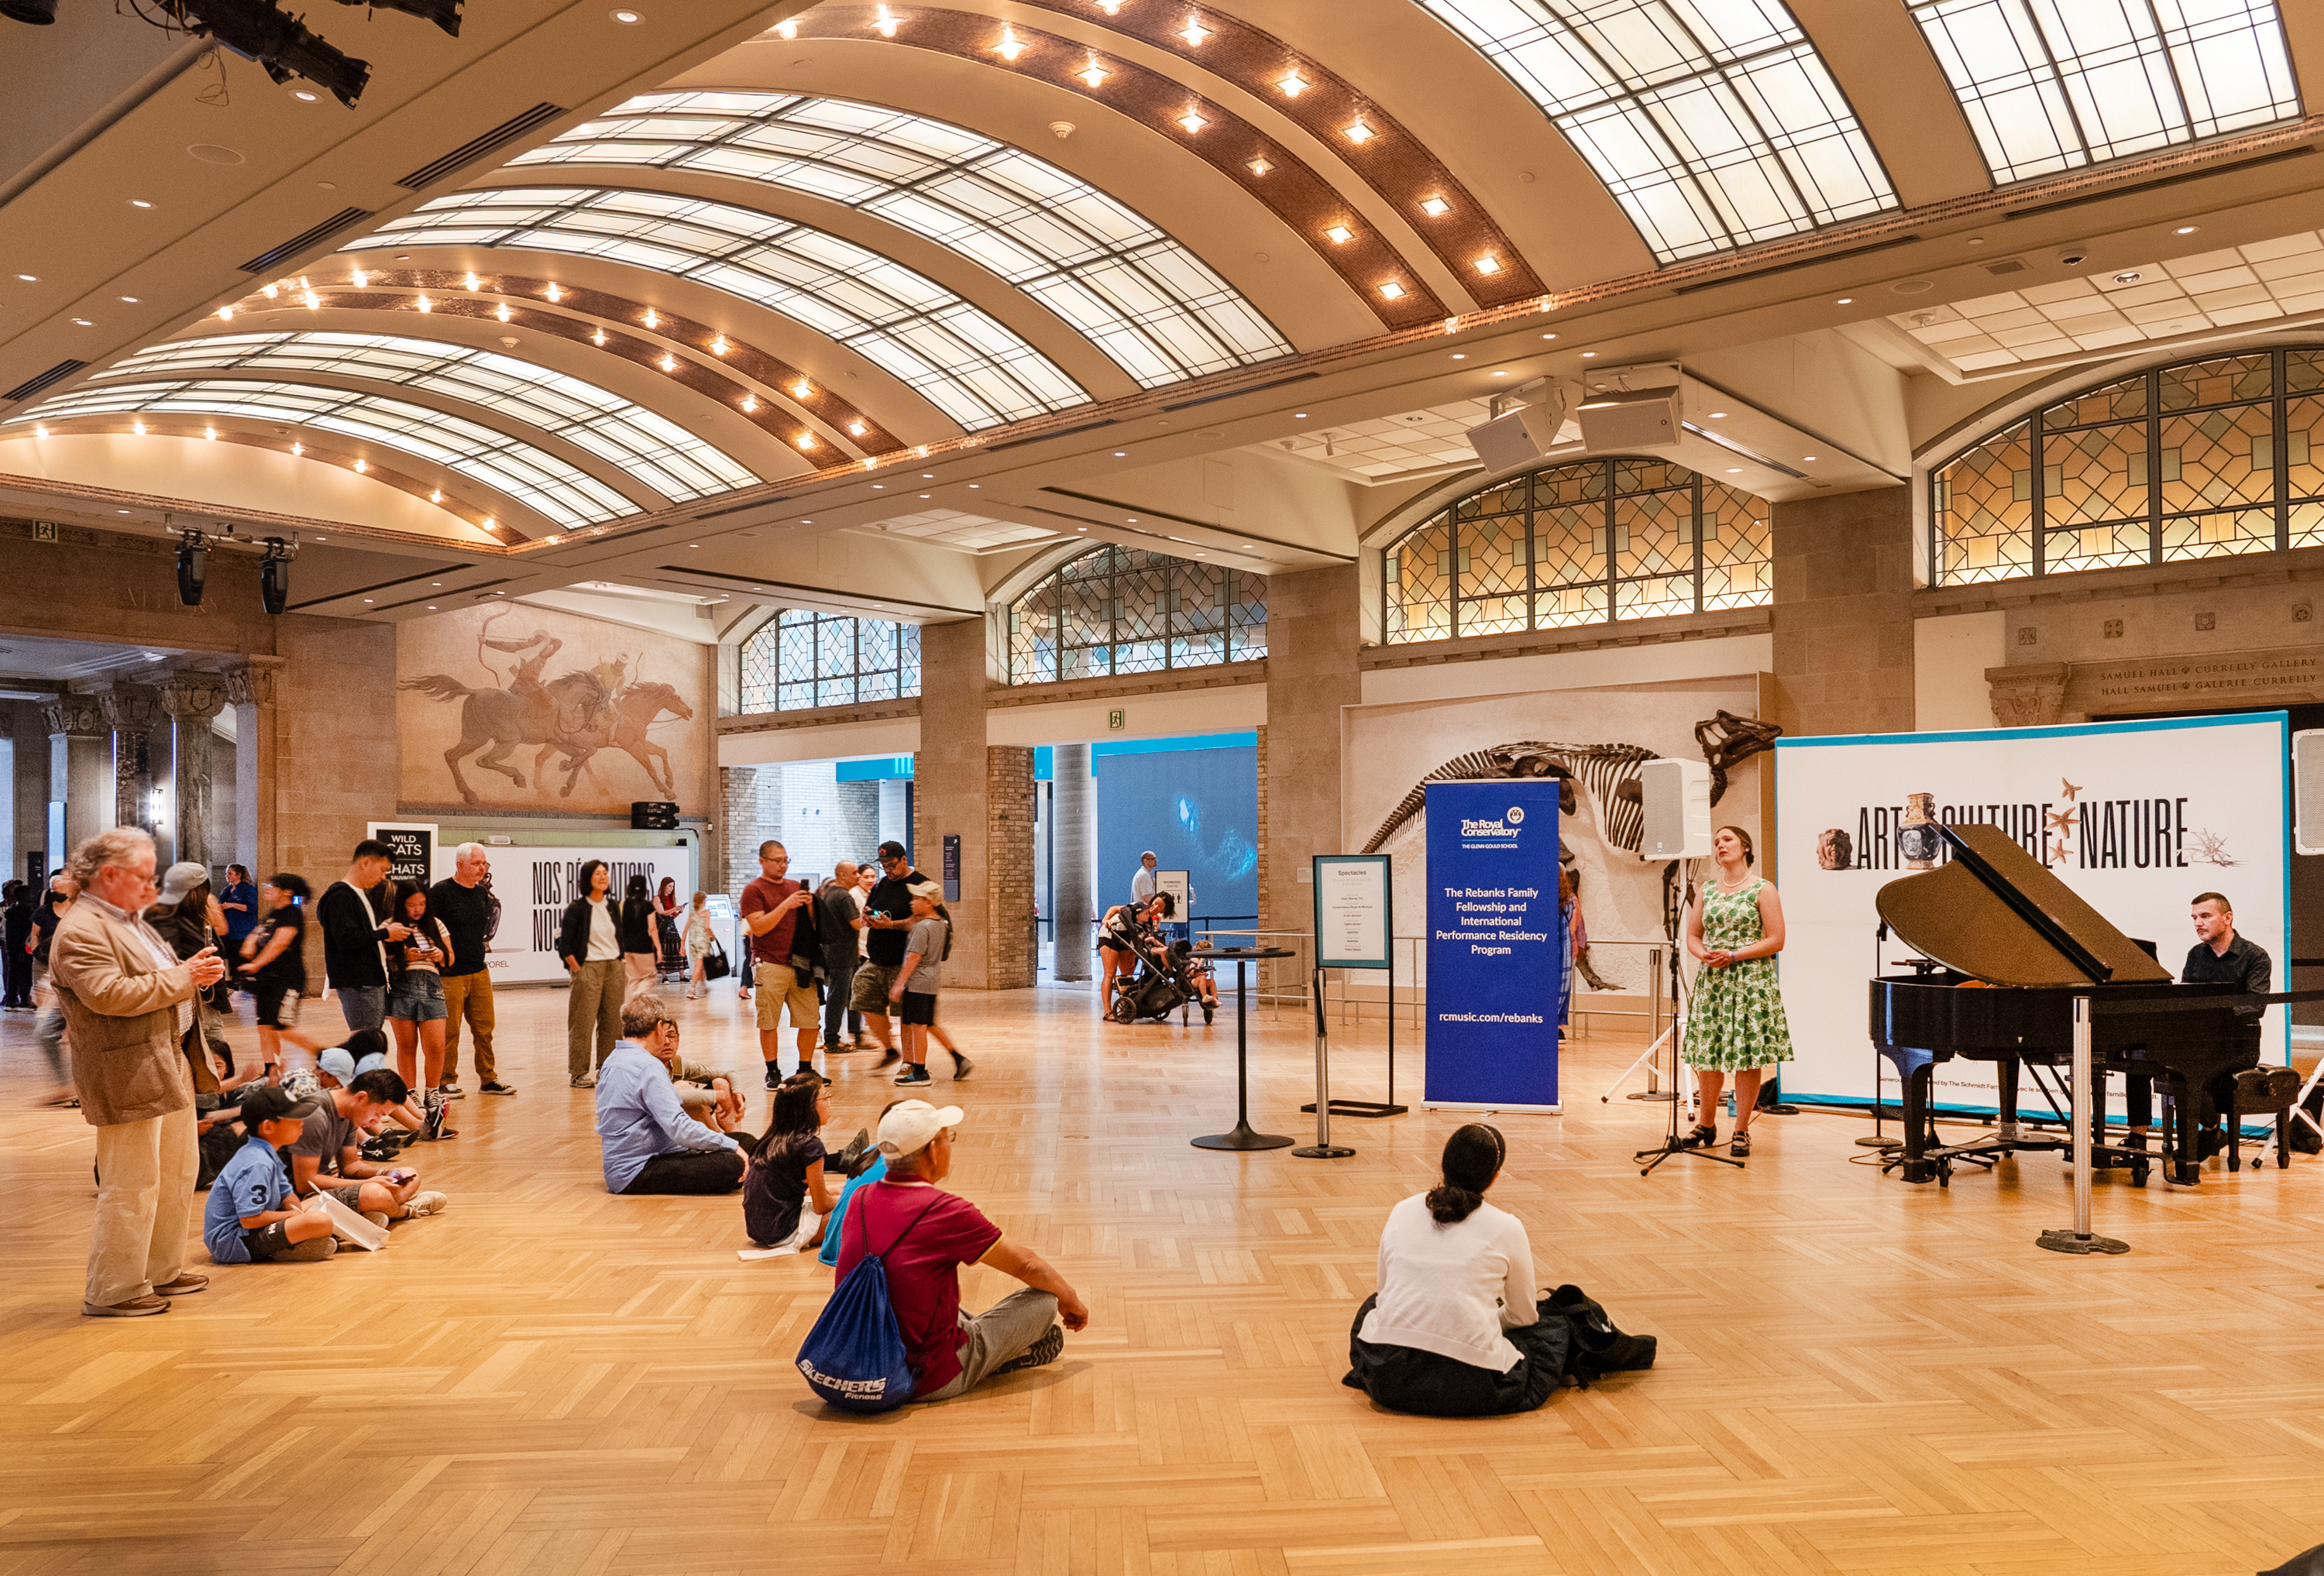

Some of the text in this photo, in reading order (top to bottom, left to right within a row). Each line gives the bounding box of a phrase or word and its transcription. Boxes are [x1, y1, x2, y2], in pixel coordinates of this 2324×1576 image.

[2101, 659, 2316, 681] SAMUEL HALL CURRELLY GALLERY
[2102, 675, 2316, 695] HALL SAMUEL GALERIE CURRELLY
[1461, 818, 1503, 830] The Royal
[391, 835, 417, 843] WILD
[1461, 828, 1519, 839] Conservatory
[1858, 806, 1903, 870] ART
[2079, 798, 2188, 869] NATURE
[533, 861, 562, 905] NOS
[1445, 888, 1538, 899] The Rebanks Family
[1456, 902, 1527, 913] Fellowship and
[1461, 916, 1521, 925] International
[1436, 930, 1548, 943] Performance Residency
[1471, 945, 1511, 956] Program
[1439, 1012, 1543, 1023] rcmusic.com/rebanks
[251, 1184, 266, 1204] 3
[798, 1359, 886, 1393] SKECHERS
